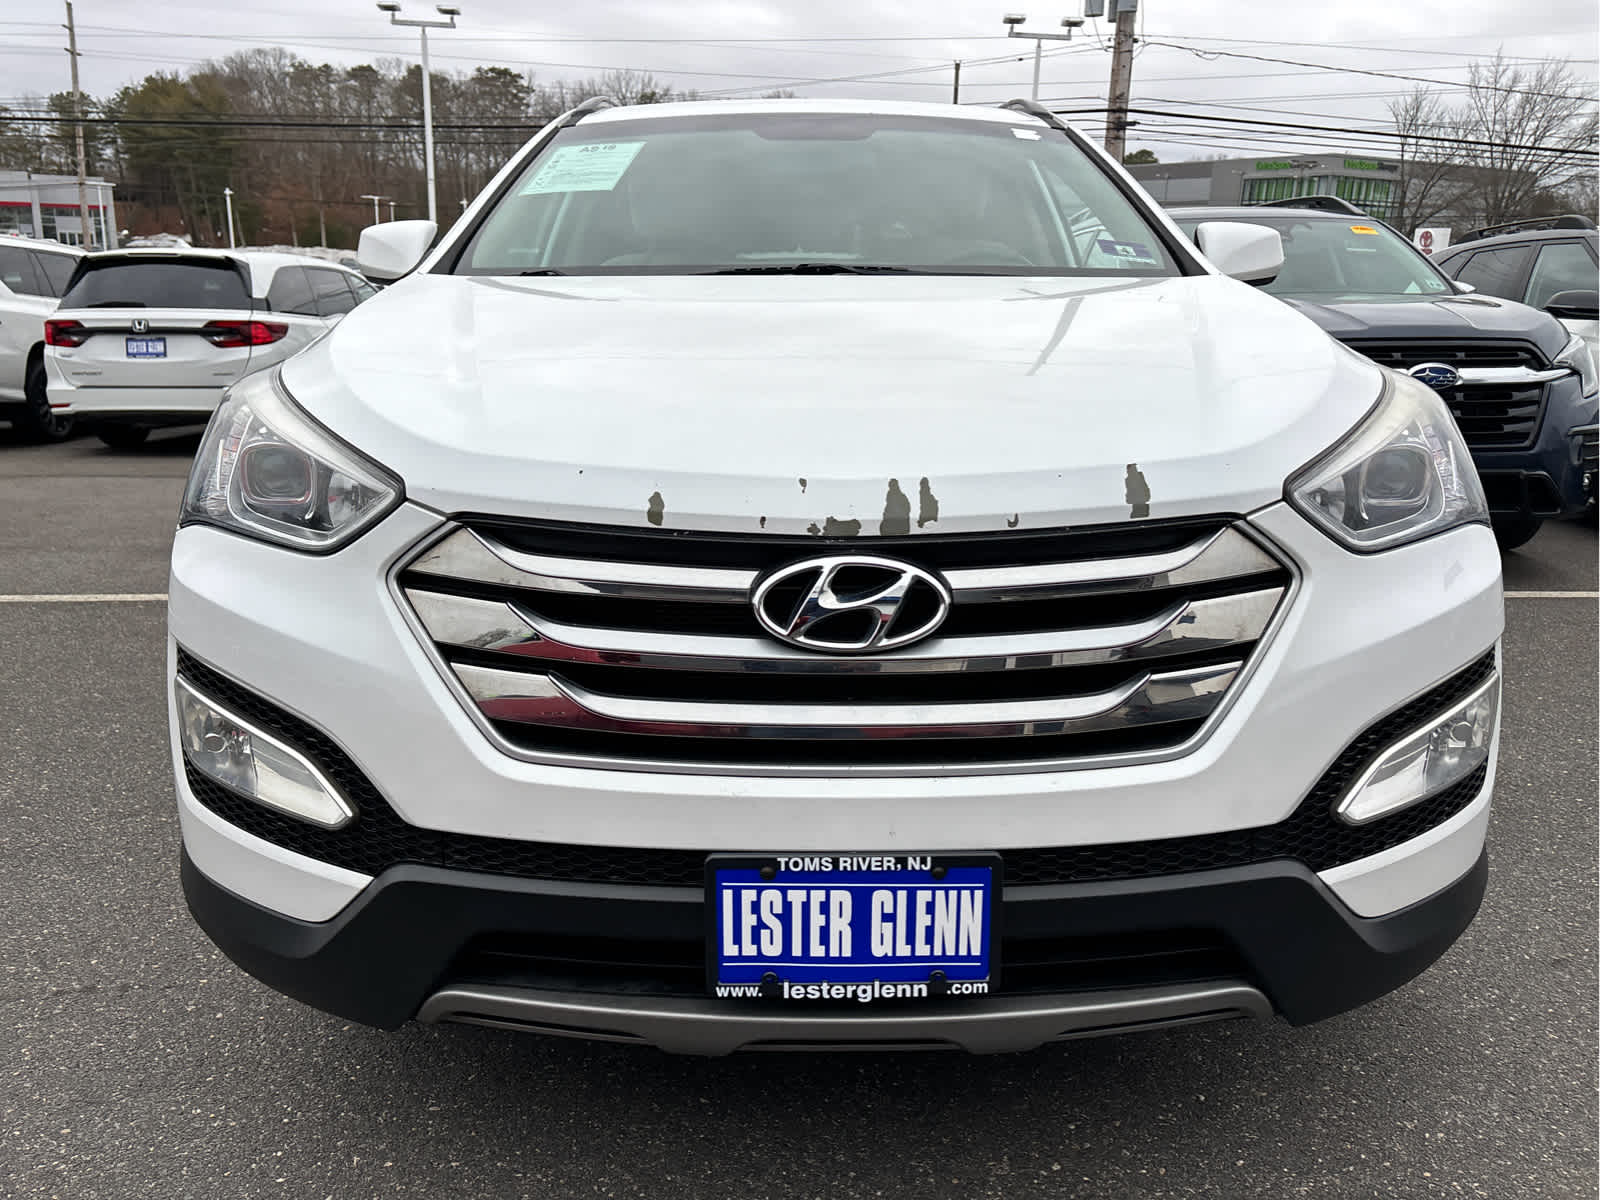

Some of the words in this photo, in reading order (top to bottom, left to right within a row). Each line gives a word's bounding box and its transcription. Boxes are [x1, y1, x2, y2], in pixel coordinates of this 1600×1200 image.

[777, 857, 833, 872] TOMS
[839, 857, 902, 872] RIVER,
[907, 856, 932, 871] NJ
[722, 888, 853, 957] LESTER
[871, 889, 984, 957] GLENN
[716, 986, 763, 998] www.
[783, 980, 928, 1003] lesterglenn
[946, 982, 989, 995] .com
